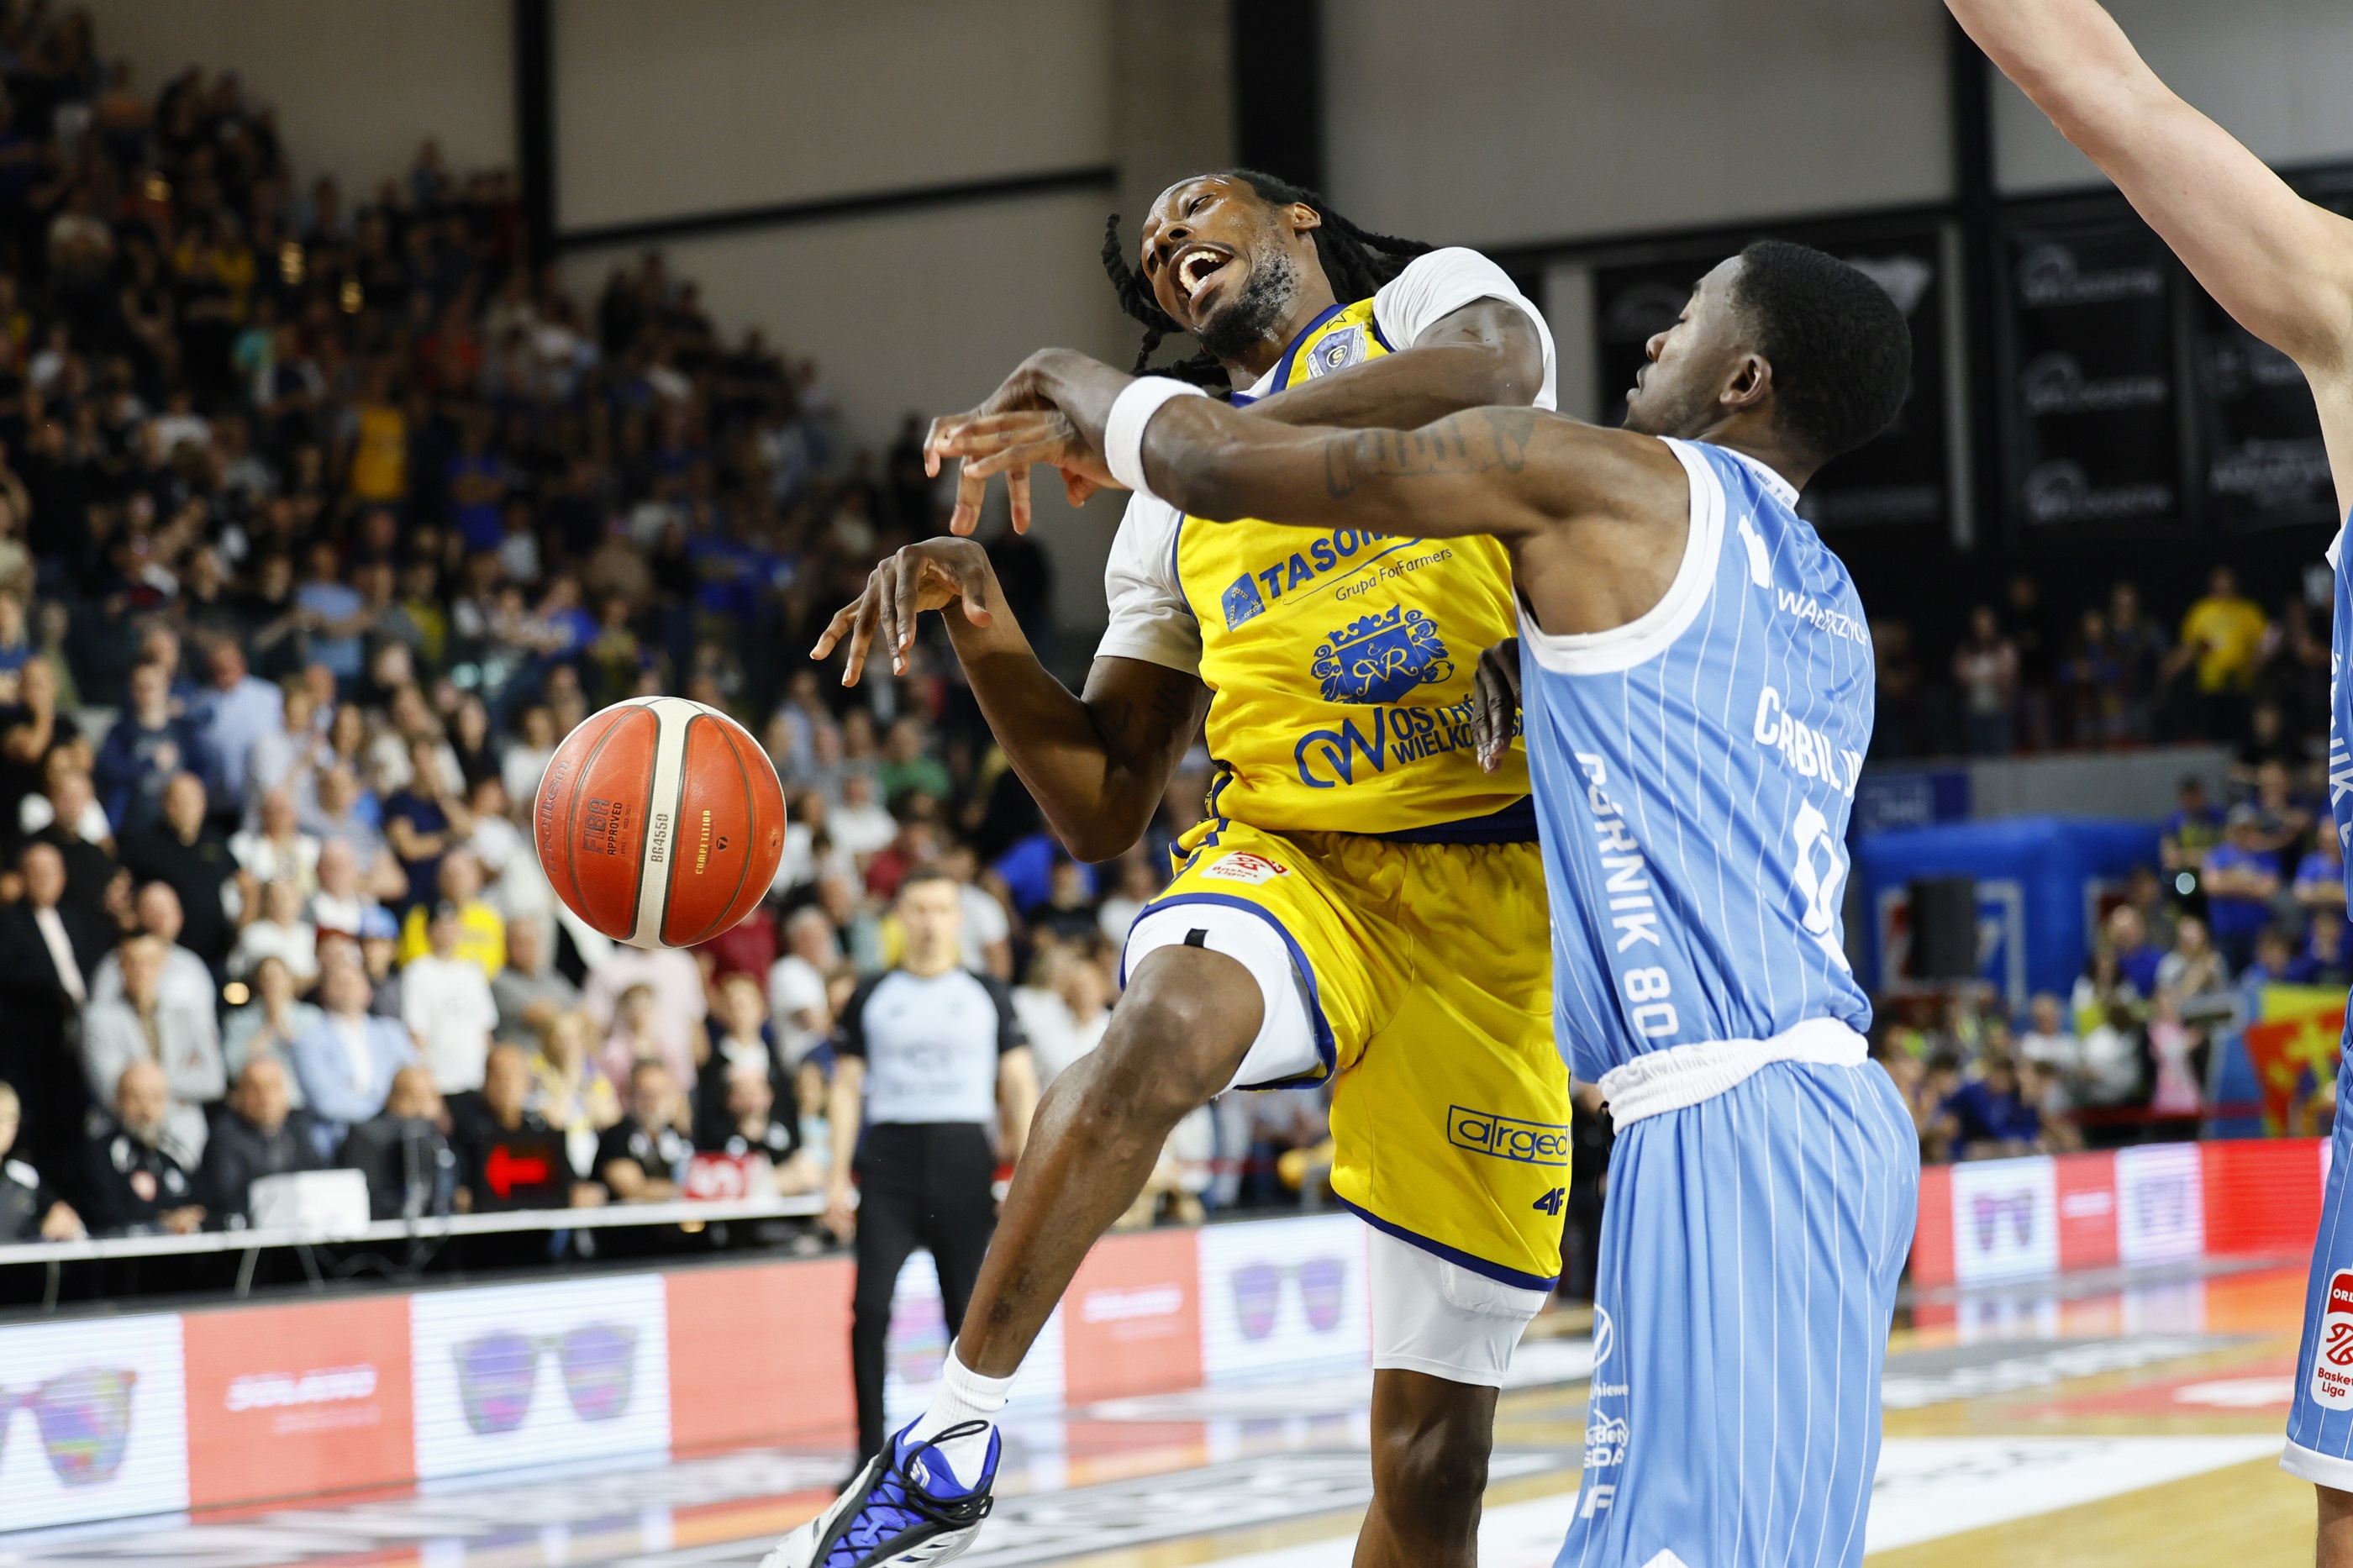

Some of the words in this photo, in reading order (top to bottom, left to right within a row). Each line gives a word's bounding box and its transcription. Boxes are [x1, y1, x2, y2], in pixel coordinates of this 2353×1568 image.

[1335, 576, 1377, 601] Grupa
[582, 798, 609, 853] FIBA
[608, 802, 622, 855] APPROVED
[650, 813, 669, 863] BG4550
[1623, 966, 1680, 1039] 80
[2322, 1381, 2346, 1397] Liga
